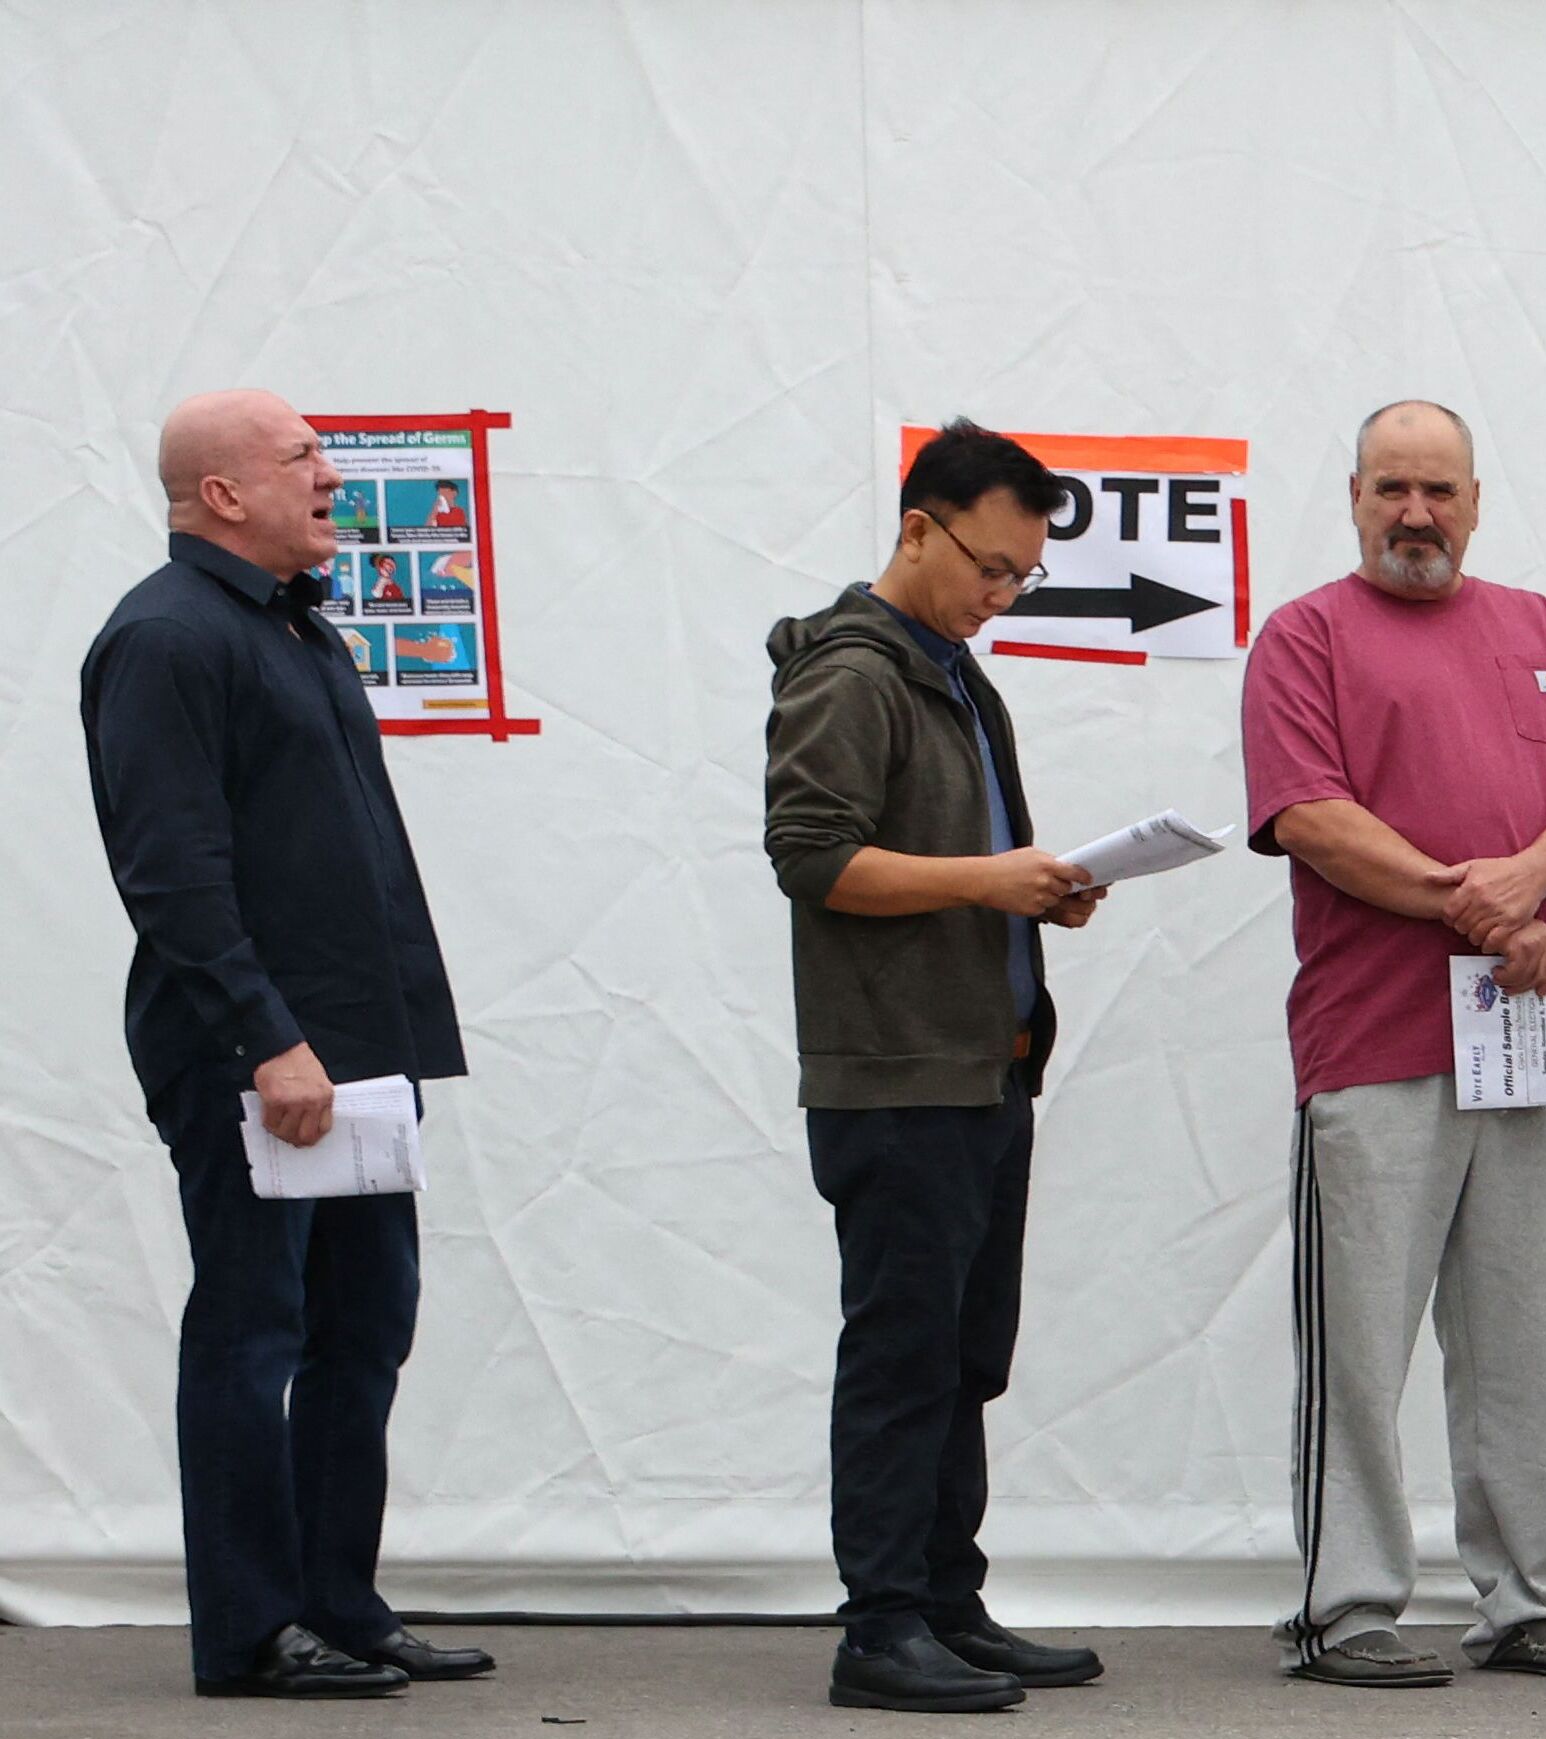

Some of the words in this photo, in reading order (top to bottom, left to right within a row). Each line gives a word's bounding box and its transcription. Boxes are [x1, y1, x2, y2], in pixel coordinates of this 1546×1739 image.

[334, 434, 355, 445] the
[359, 433, 405, 446] Spread
[407, 432, 420, 444] of
[423, 432, 466, 444] Germs
[1047, 476, 1221, 543] OTE
[1500, 1008, 1513, 1050] Sample
[1472, 1045, 1481, 1075] EARLY
[1529, 1035, 1538, 1067] GENERAL
[1472, 1078, 1482, 1102] VOTE
[1502, 1054, 1514, 1096] Official
